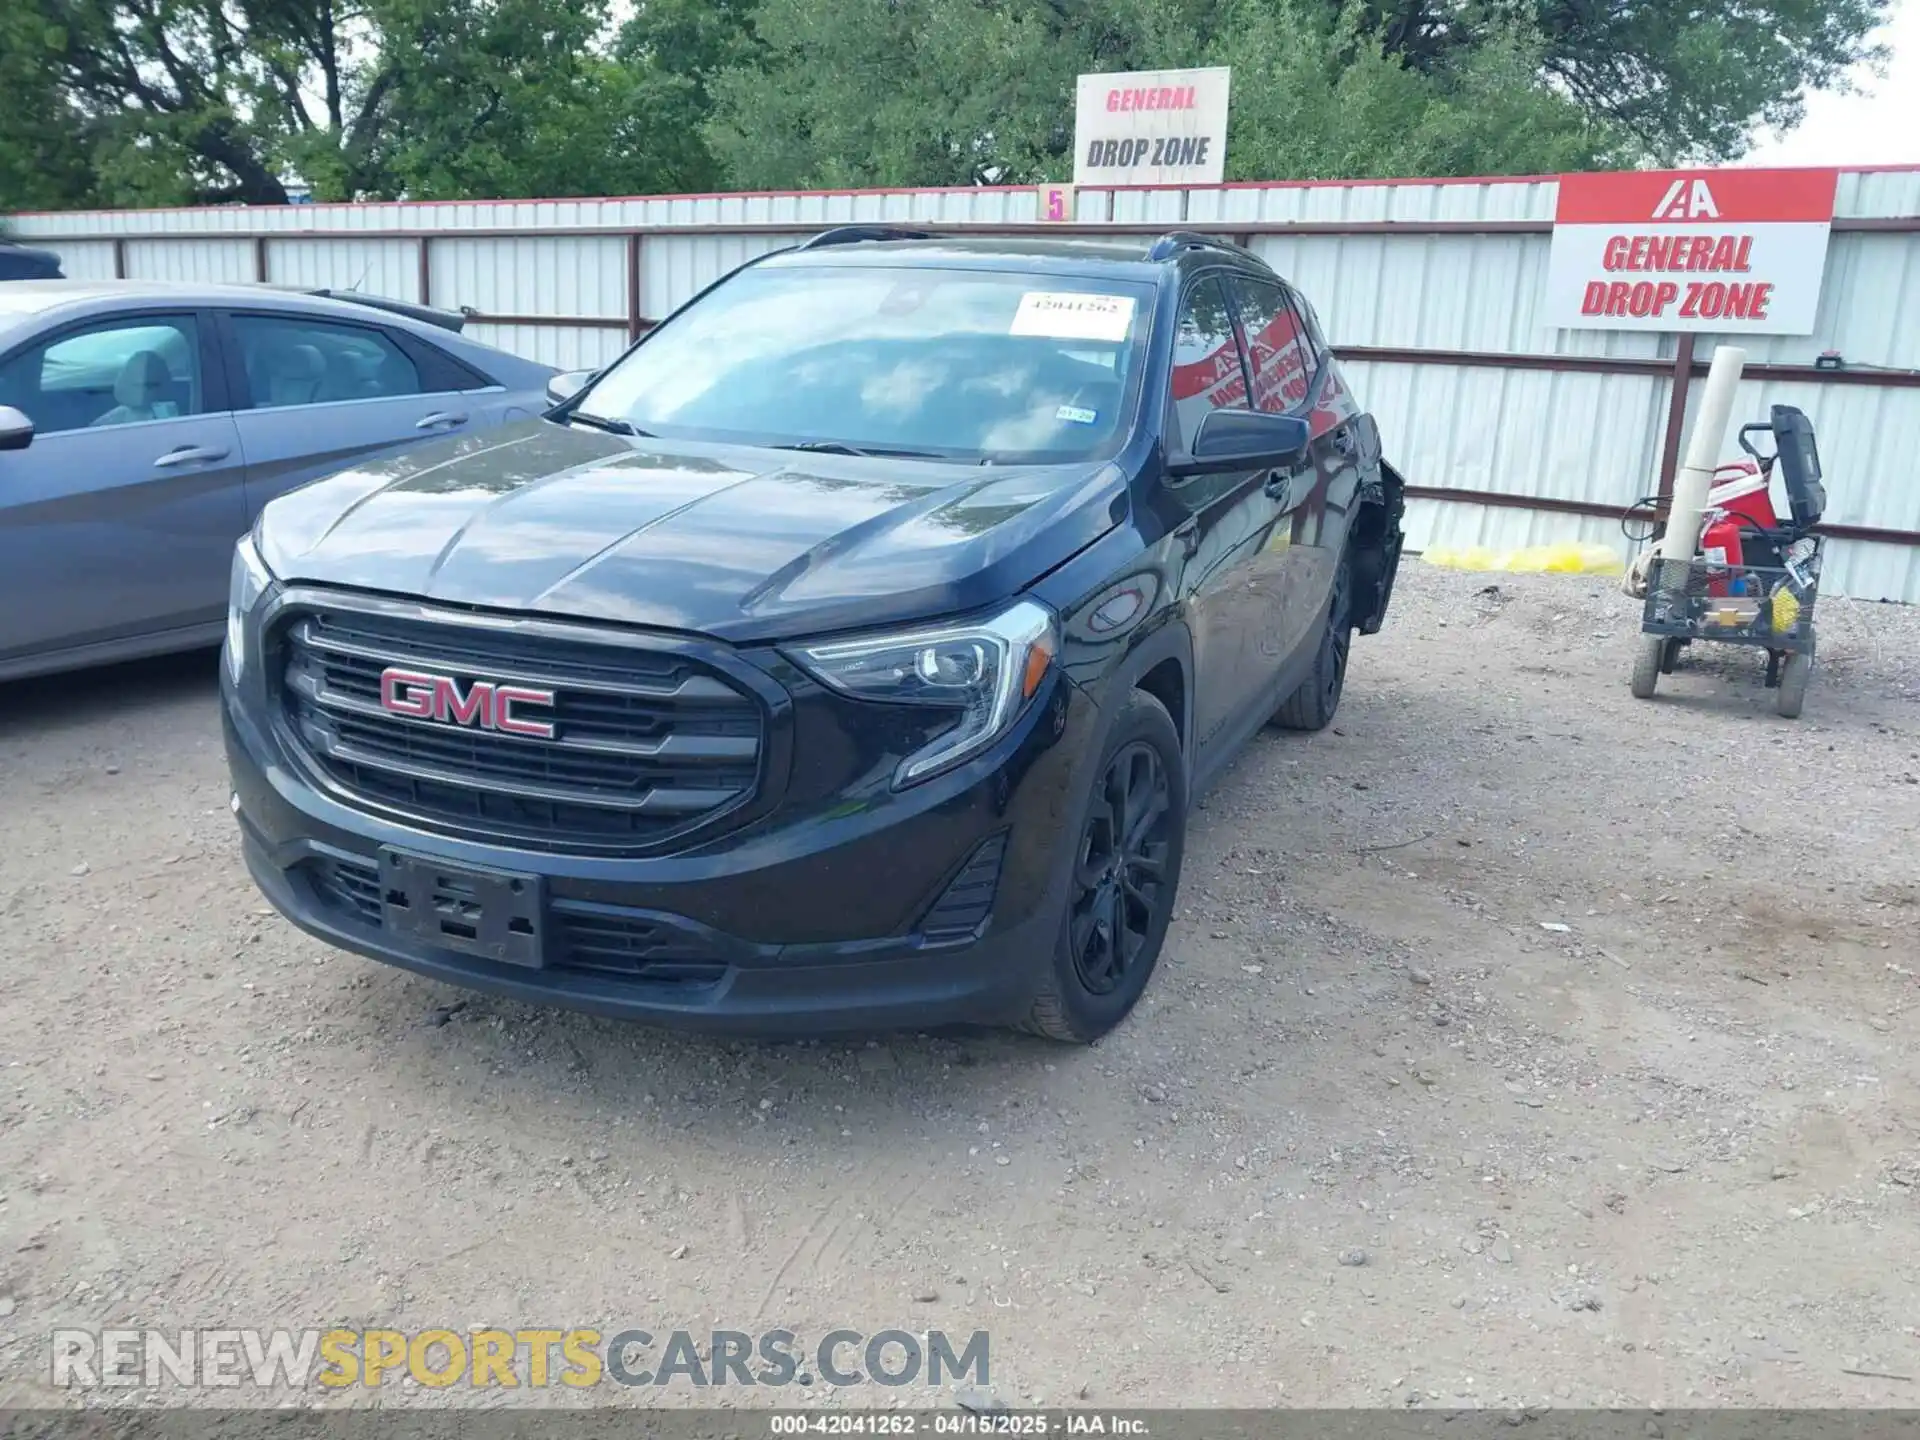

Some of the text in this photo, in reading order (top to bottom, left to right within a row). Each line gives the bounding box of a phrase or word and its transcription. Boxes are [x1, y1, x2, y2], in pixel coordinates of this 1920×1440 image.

[1106, 86, 1195, 113] GENERAL
[1086, 136, 1211, 168] DROP ZONE
[1049, 190, 1064, 221] 5
[1602, 235, 1754, 273] GENERAL
[1581, 280, 1775, 321] DROP ZONE
[380, 667, 556, 740] GMC
